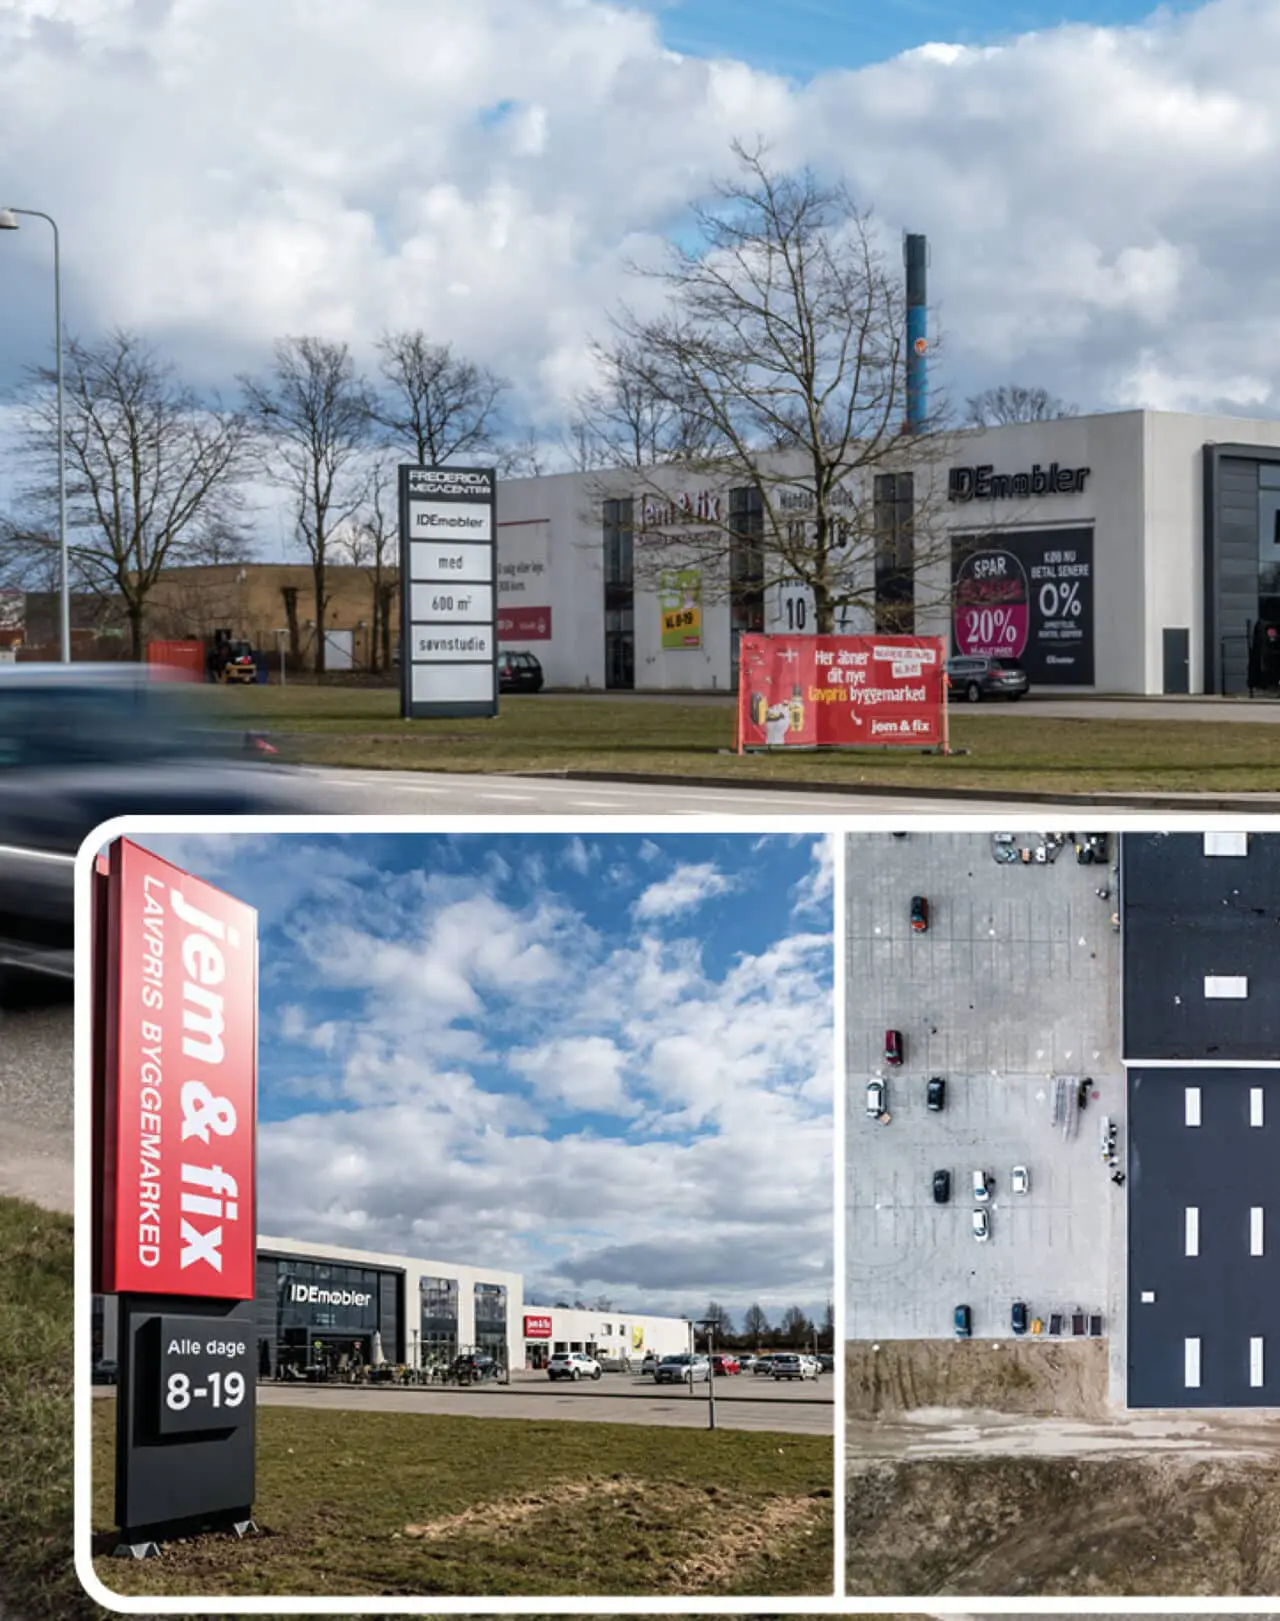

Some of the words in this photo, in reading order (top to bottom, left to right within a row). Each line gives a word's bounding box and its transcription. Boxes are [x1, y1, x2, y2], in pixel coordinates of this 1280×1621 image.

[408, 470, 490, 484] FREDERICIA
[409, 483, 491, 494] MEGACENTER
[438, 556, 463, 570] med
[1064, 550, 1076, 562] NU
[974, 556, 1007, 578] SPAR
[1031, 566, 1057, 578] BETAL
[1058, 564, 1089, 577] SENERE
[431, 596, 454, 611] 600
[1039, 582, 1082, 617] 0%
[786, 597, 806, 630] 10
[966, 608, 1018, 643] 20%
[419, 636, 486, 651] søvnstudie
[815, 650, 834, 665] Her
[837, 649, 869, 666] åbner
[827, 667, 845, 684] dit
[846, 671, 865, 685] nye
[808, 685, 848, 704] lavpris
[850, 685, 926, 705] byggemarked
[899, 719, 910, 731] &
[141, 874, 165, 1011] LAVPRIS
[170, 887, 240, 1065] jem
[180, 1080, 237, 1145] &
[139, 1020, 164, 1268] BYGGEMARKED
[180, 1163, 238, 1274] fix
[167, 1339, 200, 1355] Alle
[206, 1338, 246, 1360] dage
[166, 1371, 246, 1411] 8-19
